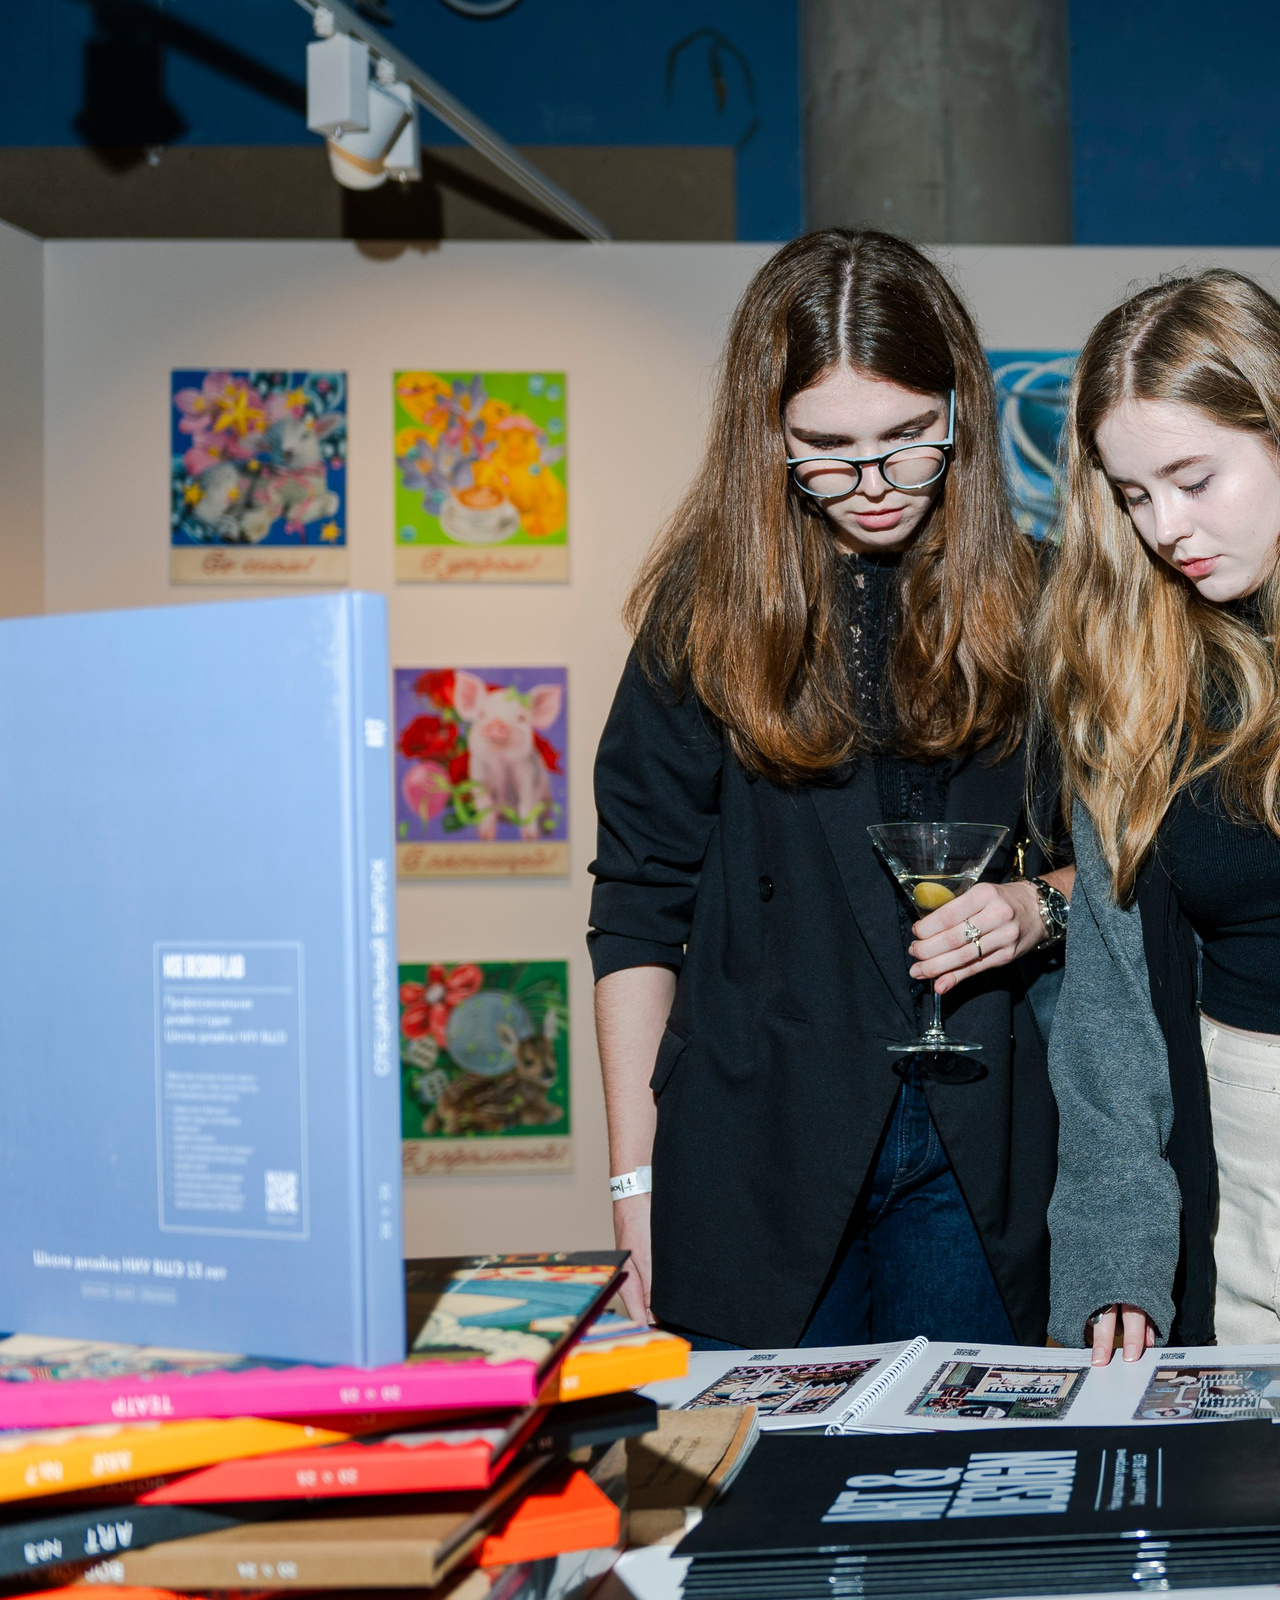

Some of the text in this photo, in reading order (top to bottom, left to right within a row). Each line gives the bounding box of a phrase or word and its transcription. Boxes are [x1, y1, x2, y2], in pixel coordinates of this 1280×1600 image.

[846, 1467, 964, 1489] &
[946, 1450, 1078, 1519] DESIGN
[821, 1490, 954, 1523] ART
[84, 1520, 134, 1556] ART
